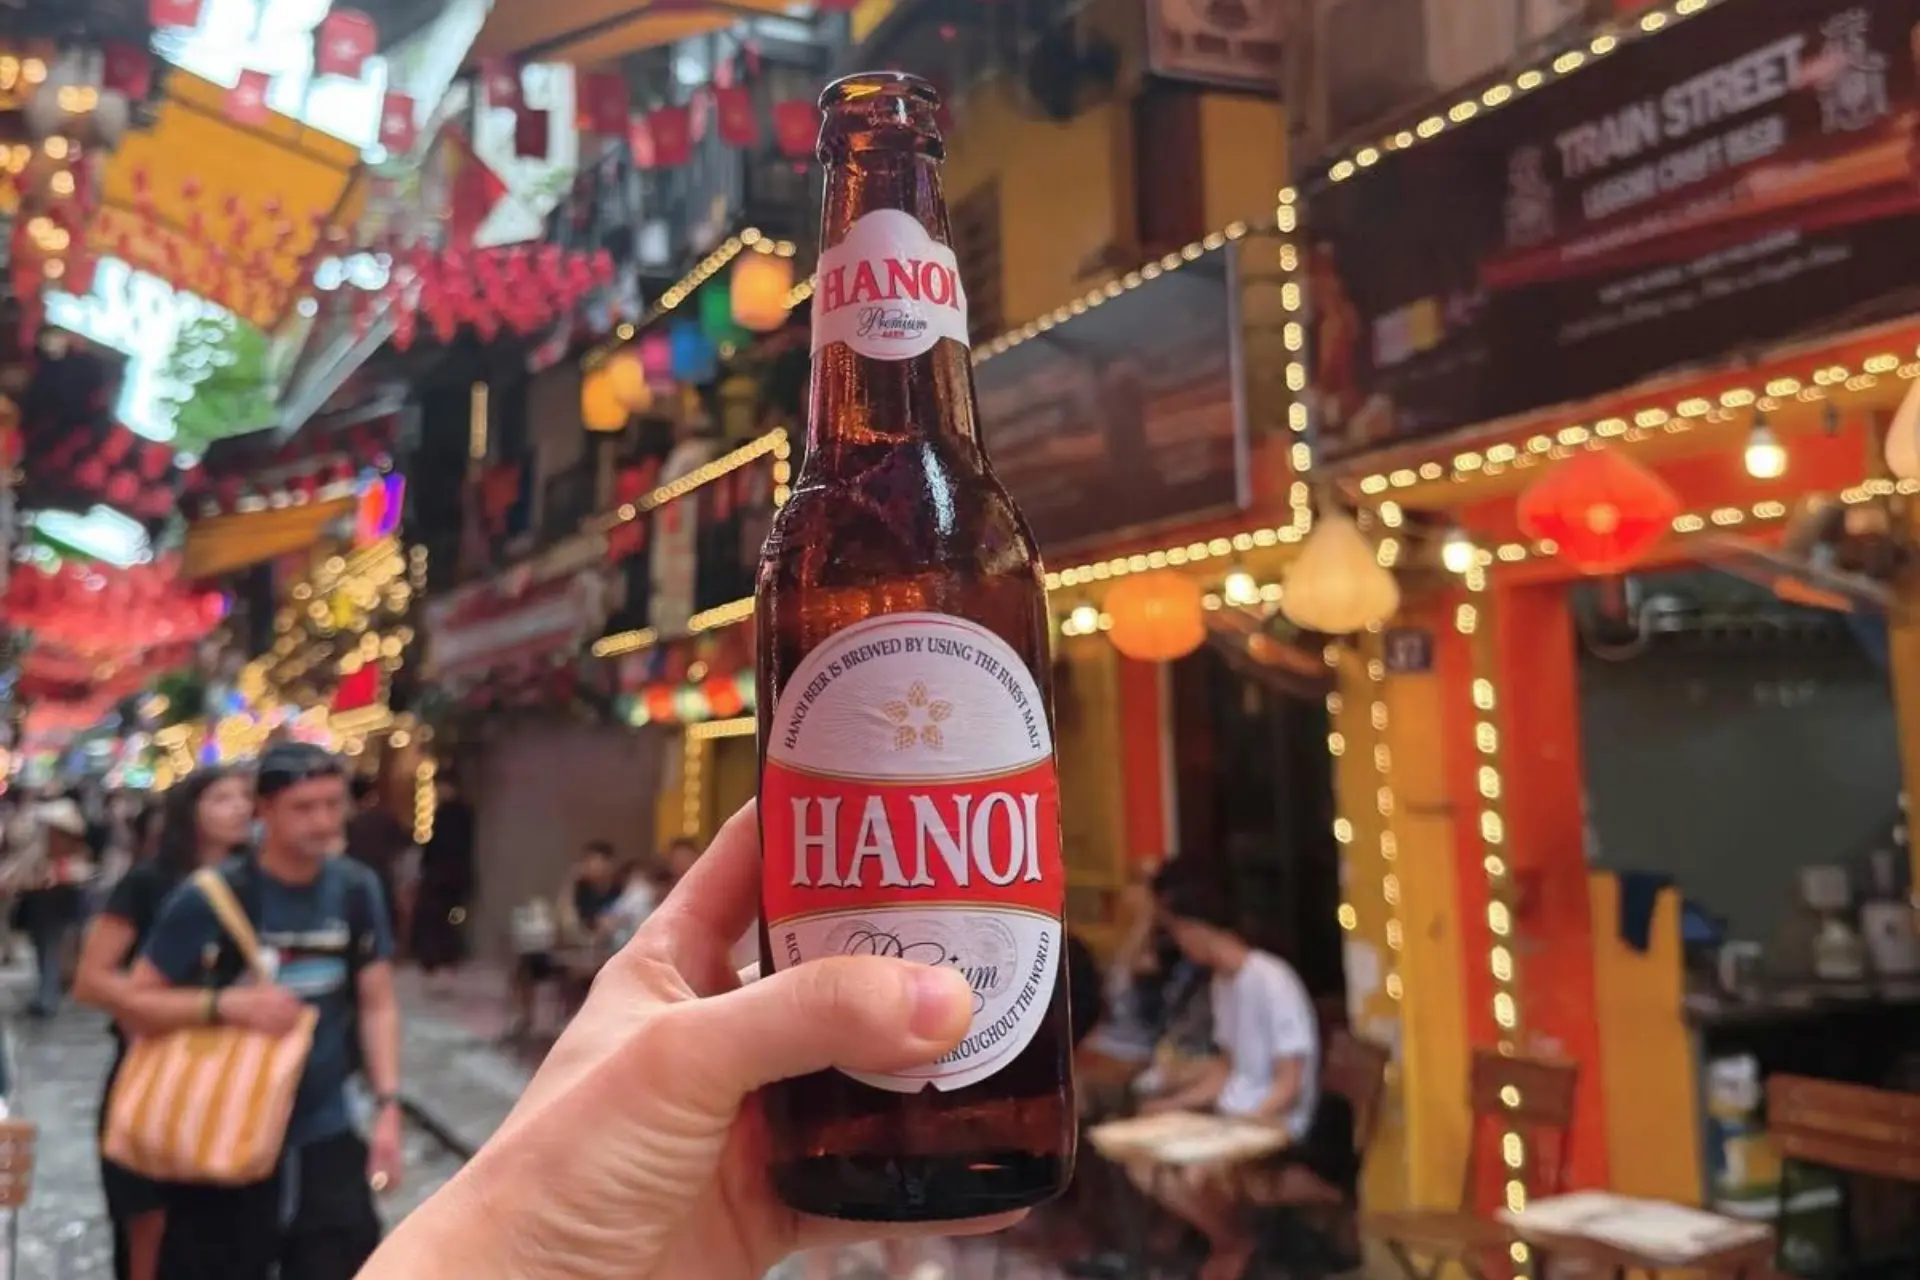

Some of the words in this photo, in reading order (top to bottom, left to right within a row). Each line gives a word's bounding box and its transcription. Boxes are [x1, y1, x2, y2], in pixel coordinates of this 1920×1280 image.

[1556, 100, 1660, 178] TRAIN
[1661, 34, 1806, 137] STREET
[822, 258, 960, 315] HANOI
[857, 307, 928, 337] Premium
[785, 702, 809, 749] HANOI
[803, 672, 832, 704] BEER
[828, 661, 843, 678] IS
[841, 638, 901, 669] BREWED
[905, 637, 924, 652] BY
[928, 637, 973, 661] USING
[974, 650, 1000, 676] THE
[996, 667, 1029, 709] FINEST
[1022, 708, 1040, 749] MALT
[790, 792, 1042, 888] HANOI
[1016, 981, 1037, 1012] THE
[1029, 931, 1050, 986] WORLD
